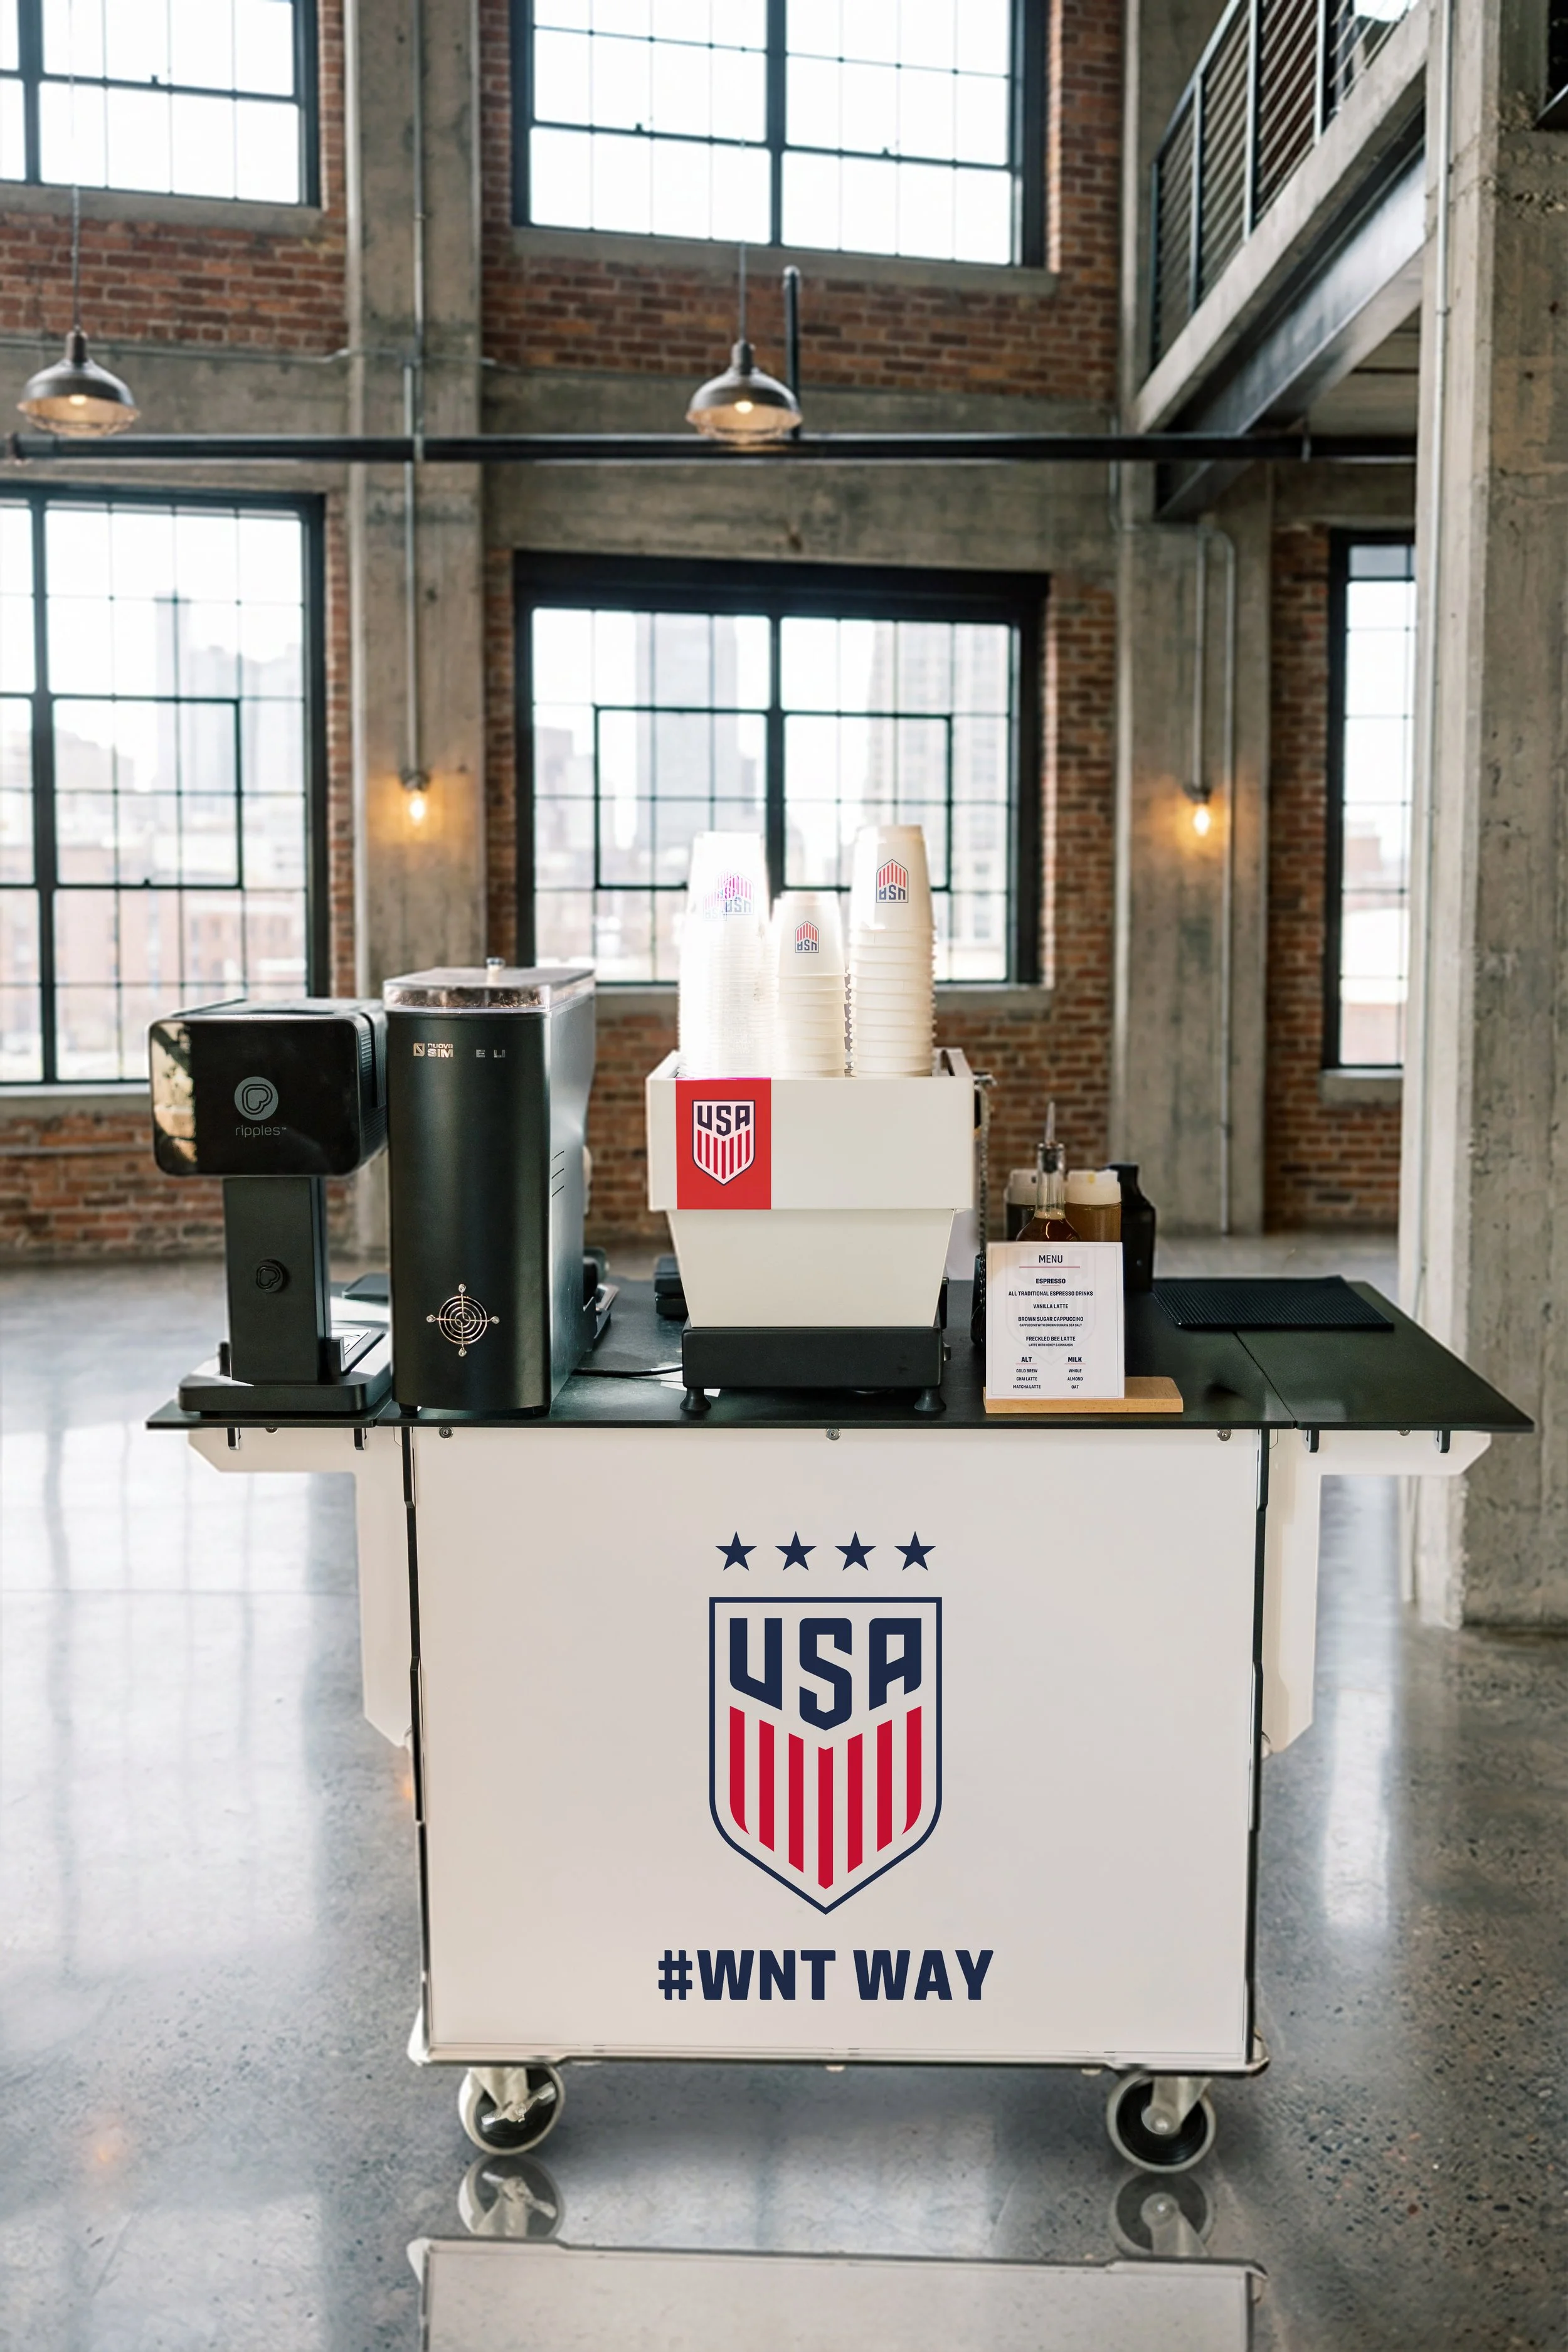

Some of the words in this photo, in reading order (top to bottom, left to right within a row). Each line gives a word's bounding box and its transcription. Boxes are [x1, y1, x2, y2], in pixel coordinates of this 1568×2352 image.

[879, 884, 906, 900] USA
[797, 940, 817, 951] USA
[697, 1106, 750, 1136] USA
[1039, 1255, 1062, 1263] MENU
[730, 1618, 921, 1730] USA
[659, 1950, 835, 2000] #WNT
[853, 1950, 993, 2000] WAY
